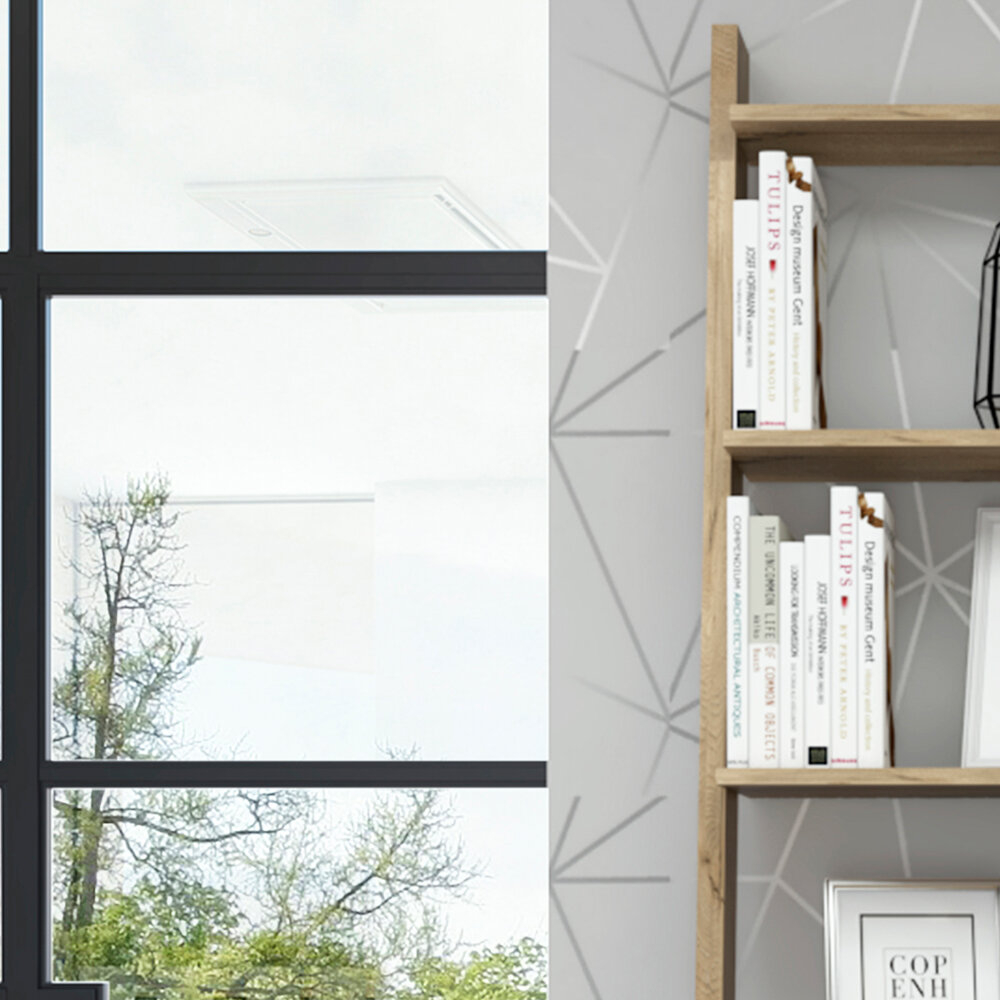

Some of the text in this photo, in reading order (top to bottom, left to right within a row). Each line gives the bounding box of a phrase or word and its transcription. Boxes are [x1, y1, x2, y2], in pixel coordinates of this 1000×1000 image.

[768, 170, 781, 251] TULIPS
[746, 246, 755, 268] JOSEF
[790, 205, 803, 326] Design museum Gent
[768, 287, 775, 300] BY
[839, 506, 853, 587] TULIPS
[817, 581, 826, 604] JOSEF
[862, 541, 875, 663] Design museum Gent
[733, 516, 742, 738] COMPENDIUM ARCHITECTURAL ANTIQUES
[765, 527, 775, 760] THE UNCOMMON LIFE OF COMMON OBJECTS
[840, 624, 847, 638] BY
[889, 954, 947, 975] COP
[892, 978, 947, 998] ENH
